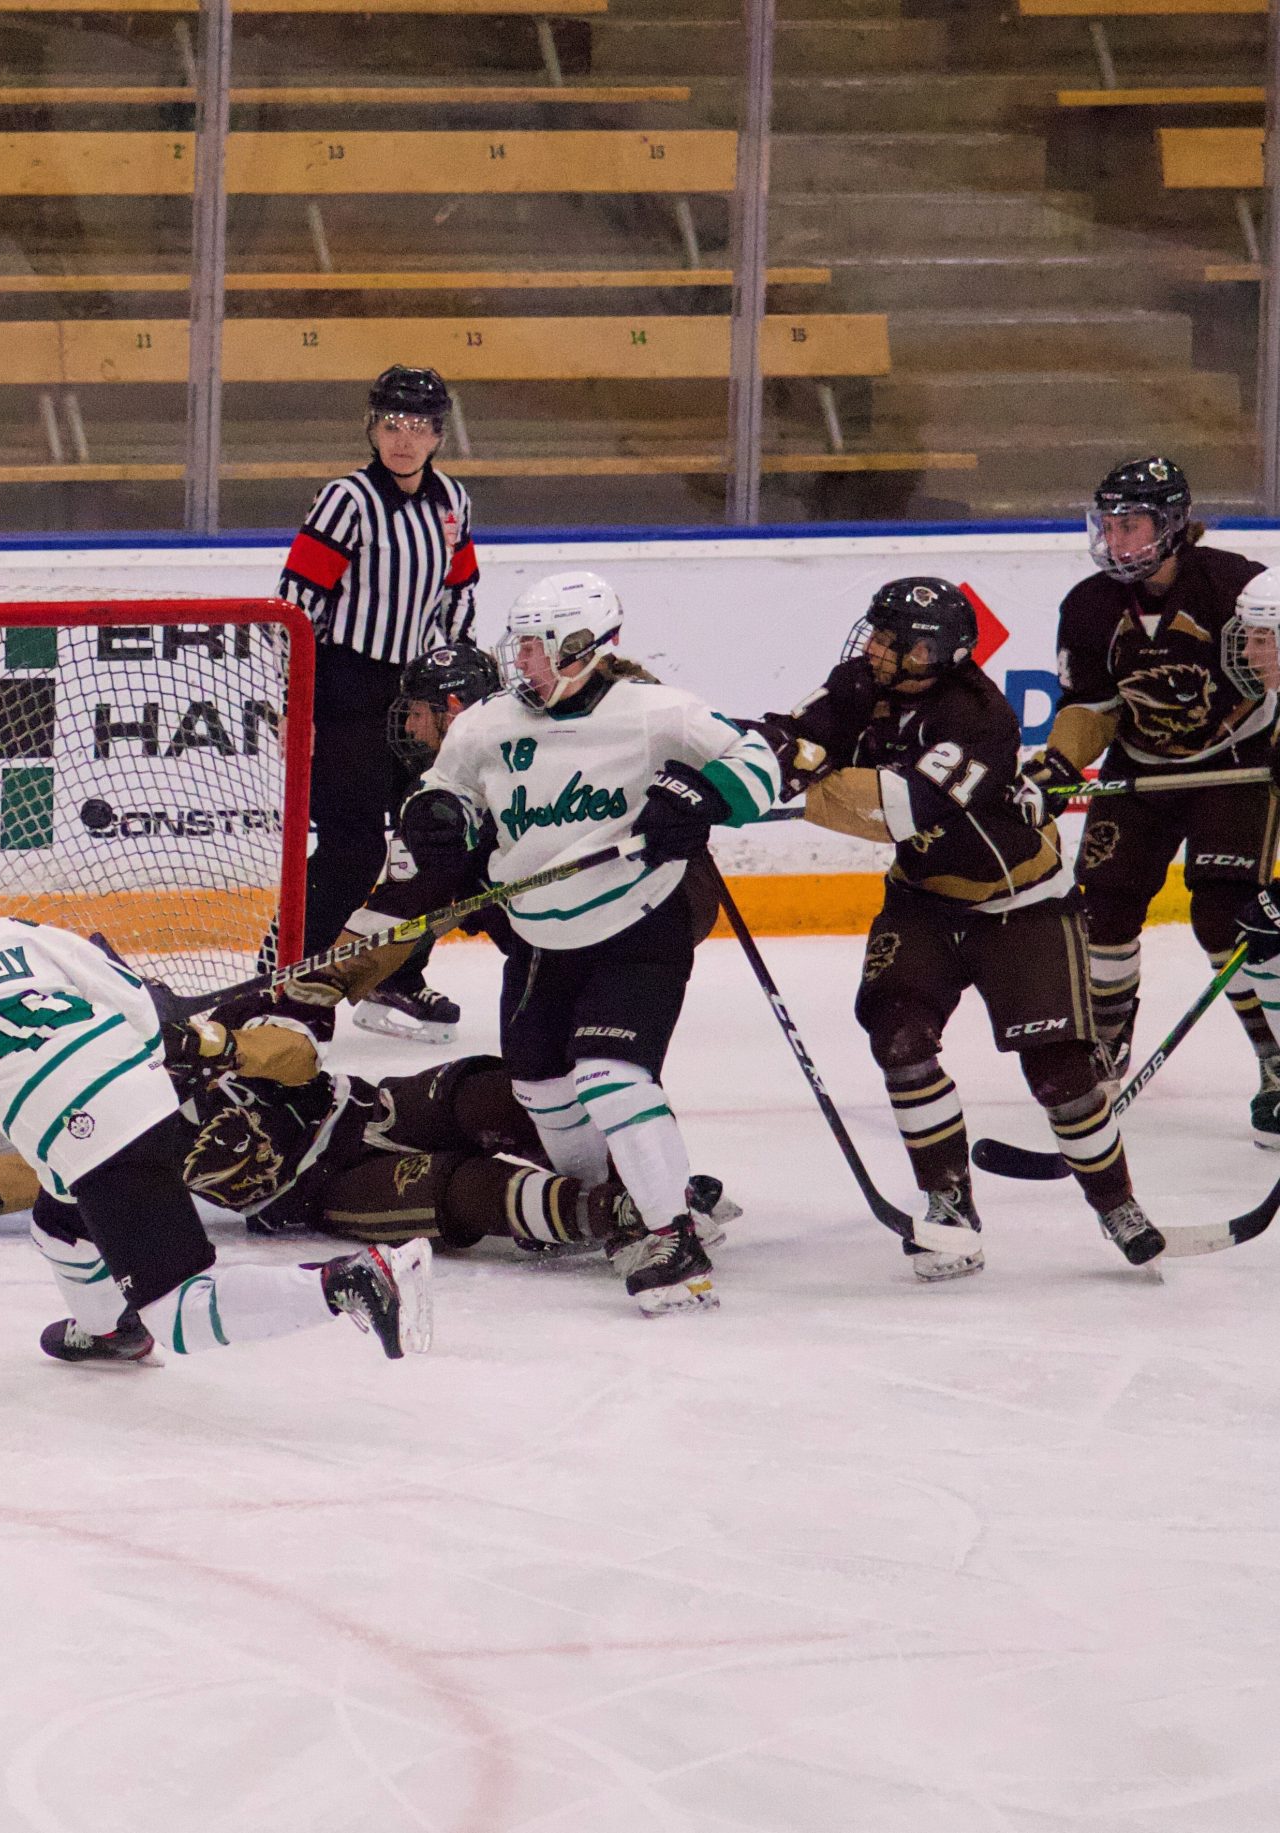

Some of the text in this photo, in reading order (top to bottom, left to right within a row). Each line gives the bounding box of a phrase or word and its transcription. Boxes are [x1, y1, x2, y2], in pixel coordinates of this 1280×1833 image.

[912, 622, 940, 631] CCM
[500, 737, 538, 774] 18
[915, 741, 989, 808] 21
[500, 770, 628, 842] Huskies
[1195, 854, 1256, 869] CCM
[574, 1026, 637, 1041] BAUER
[1005, 1017, 1068, 1038] CCM
